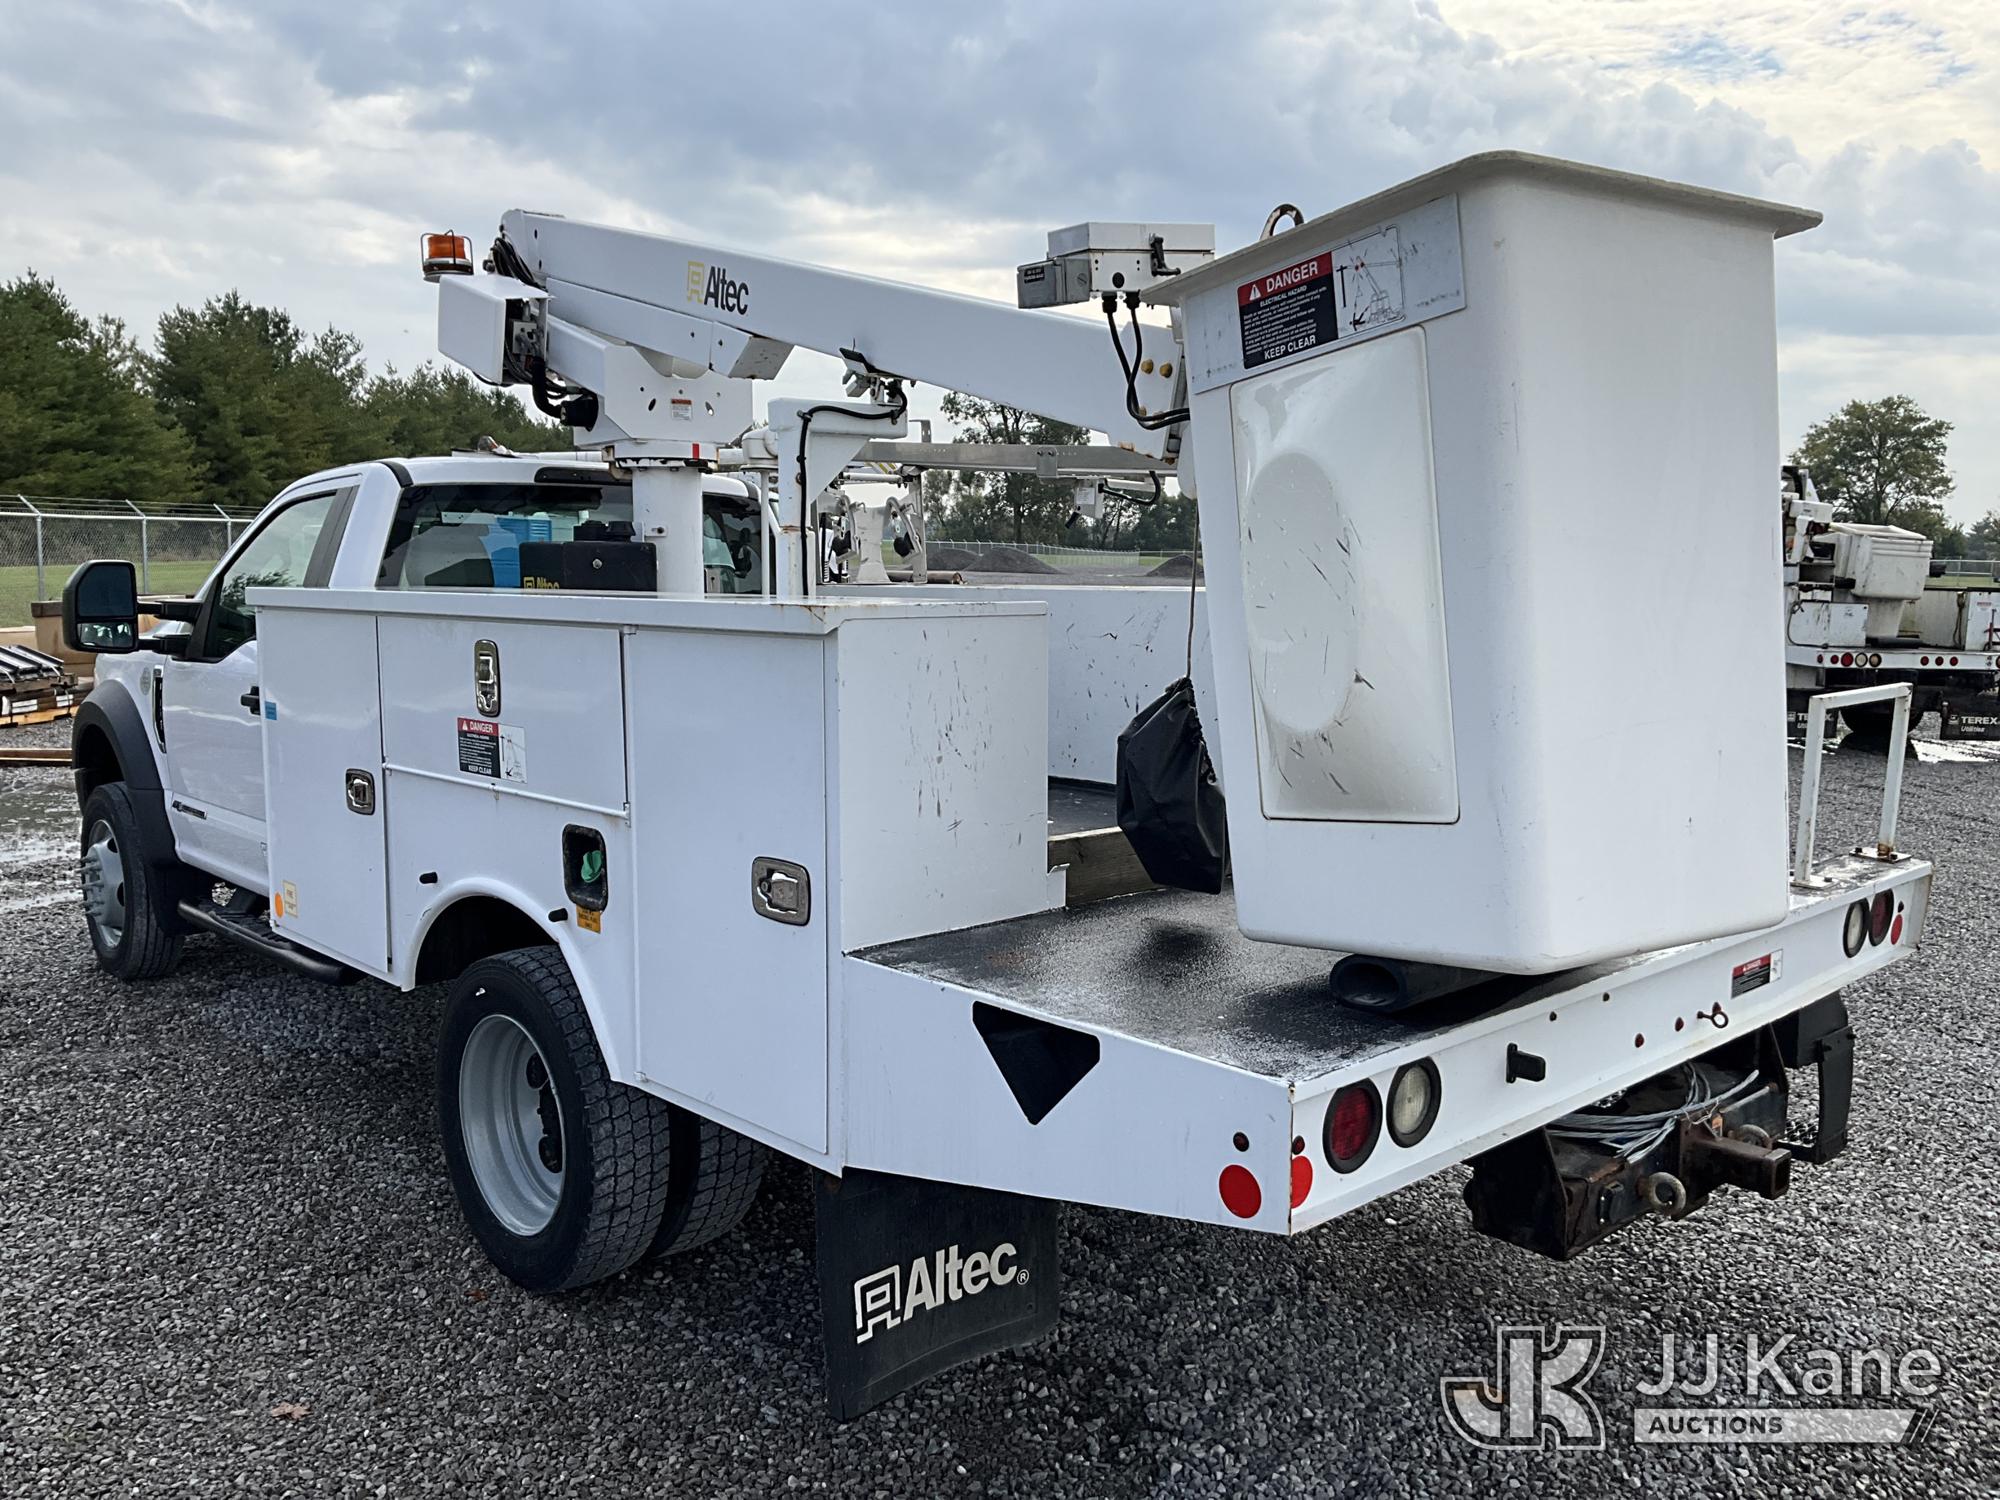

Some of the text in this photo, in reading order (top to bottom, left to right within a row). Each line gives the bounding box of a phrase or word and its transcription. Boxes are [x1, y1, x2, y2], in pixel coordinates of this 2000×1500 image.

[1266, 260, 1319, 293] DANGER
[704, 266, 749, 315] Altec
[1259, 284, 1308, 307] ELECTRICAL HAZARD
[1264, 334, 1316, 360] KEEP CLEAR
[469, 721, 494, 733] DANGER
[1960, 716, 1998, 725] TEREX
[478, 766, 492, 775] CLEAR
[903, 1242, 1018, 1321] Altec
